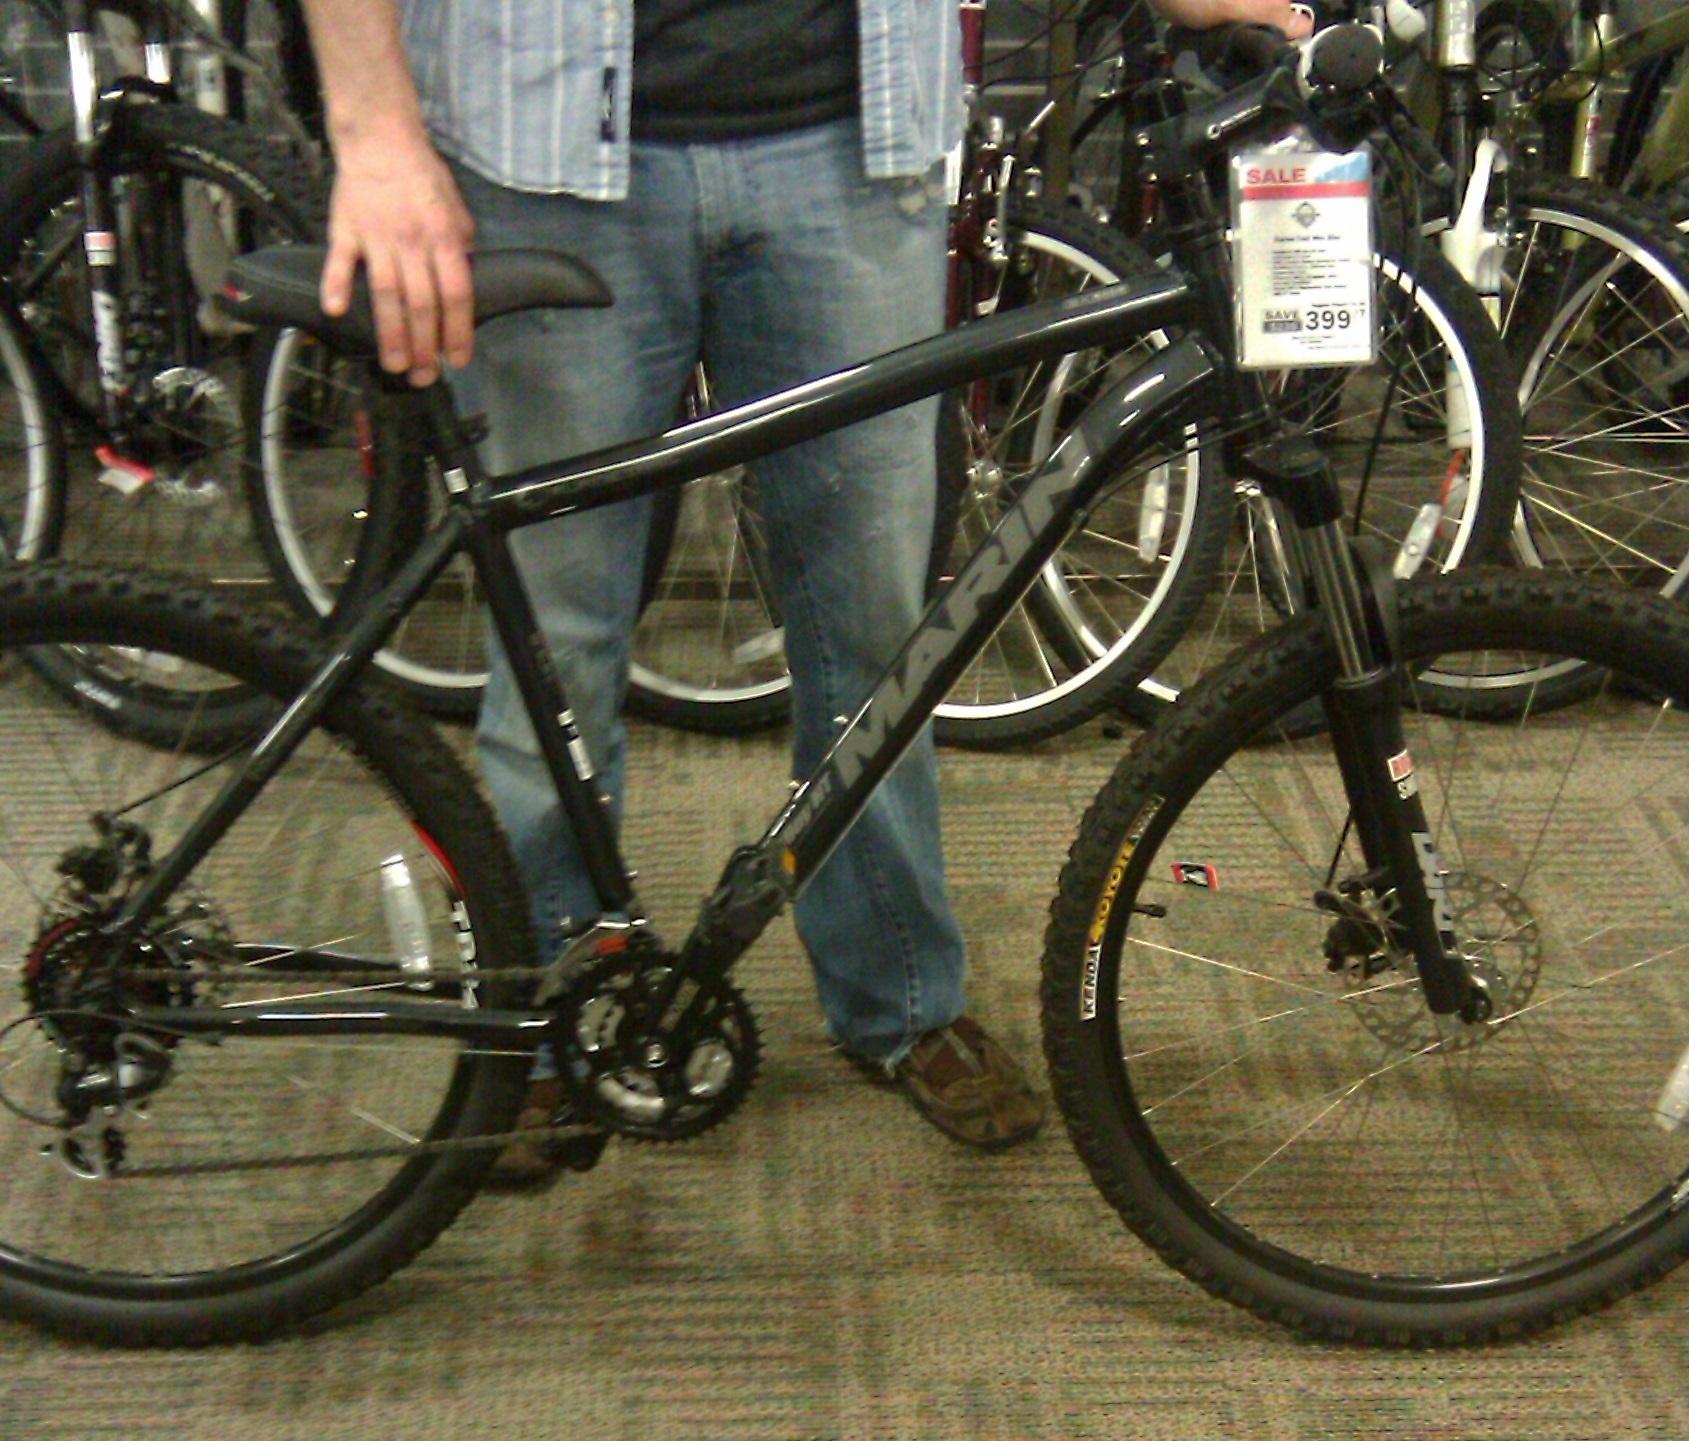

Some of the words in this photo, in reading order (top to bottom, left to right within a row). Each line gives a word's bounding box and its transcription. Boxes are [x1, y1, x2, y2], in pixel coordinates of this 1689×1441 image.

[1246, 167, 1306, 184] SALE
[1304, 309, 1351, 331] 399
[831, 428, 1094, 789] MARIN
[1082, 948, 1099, 1014] KENDA
